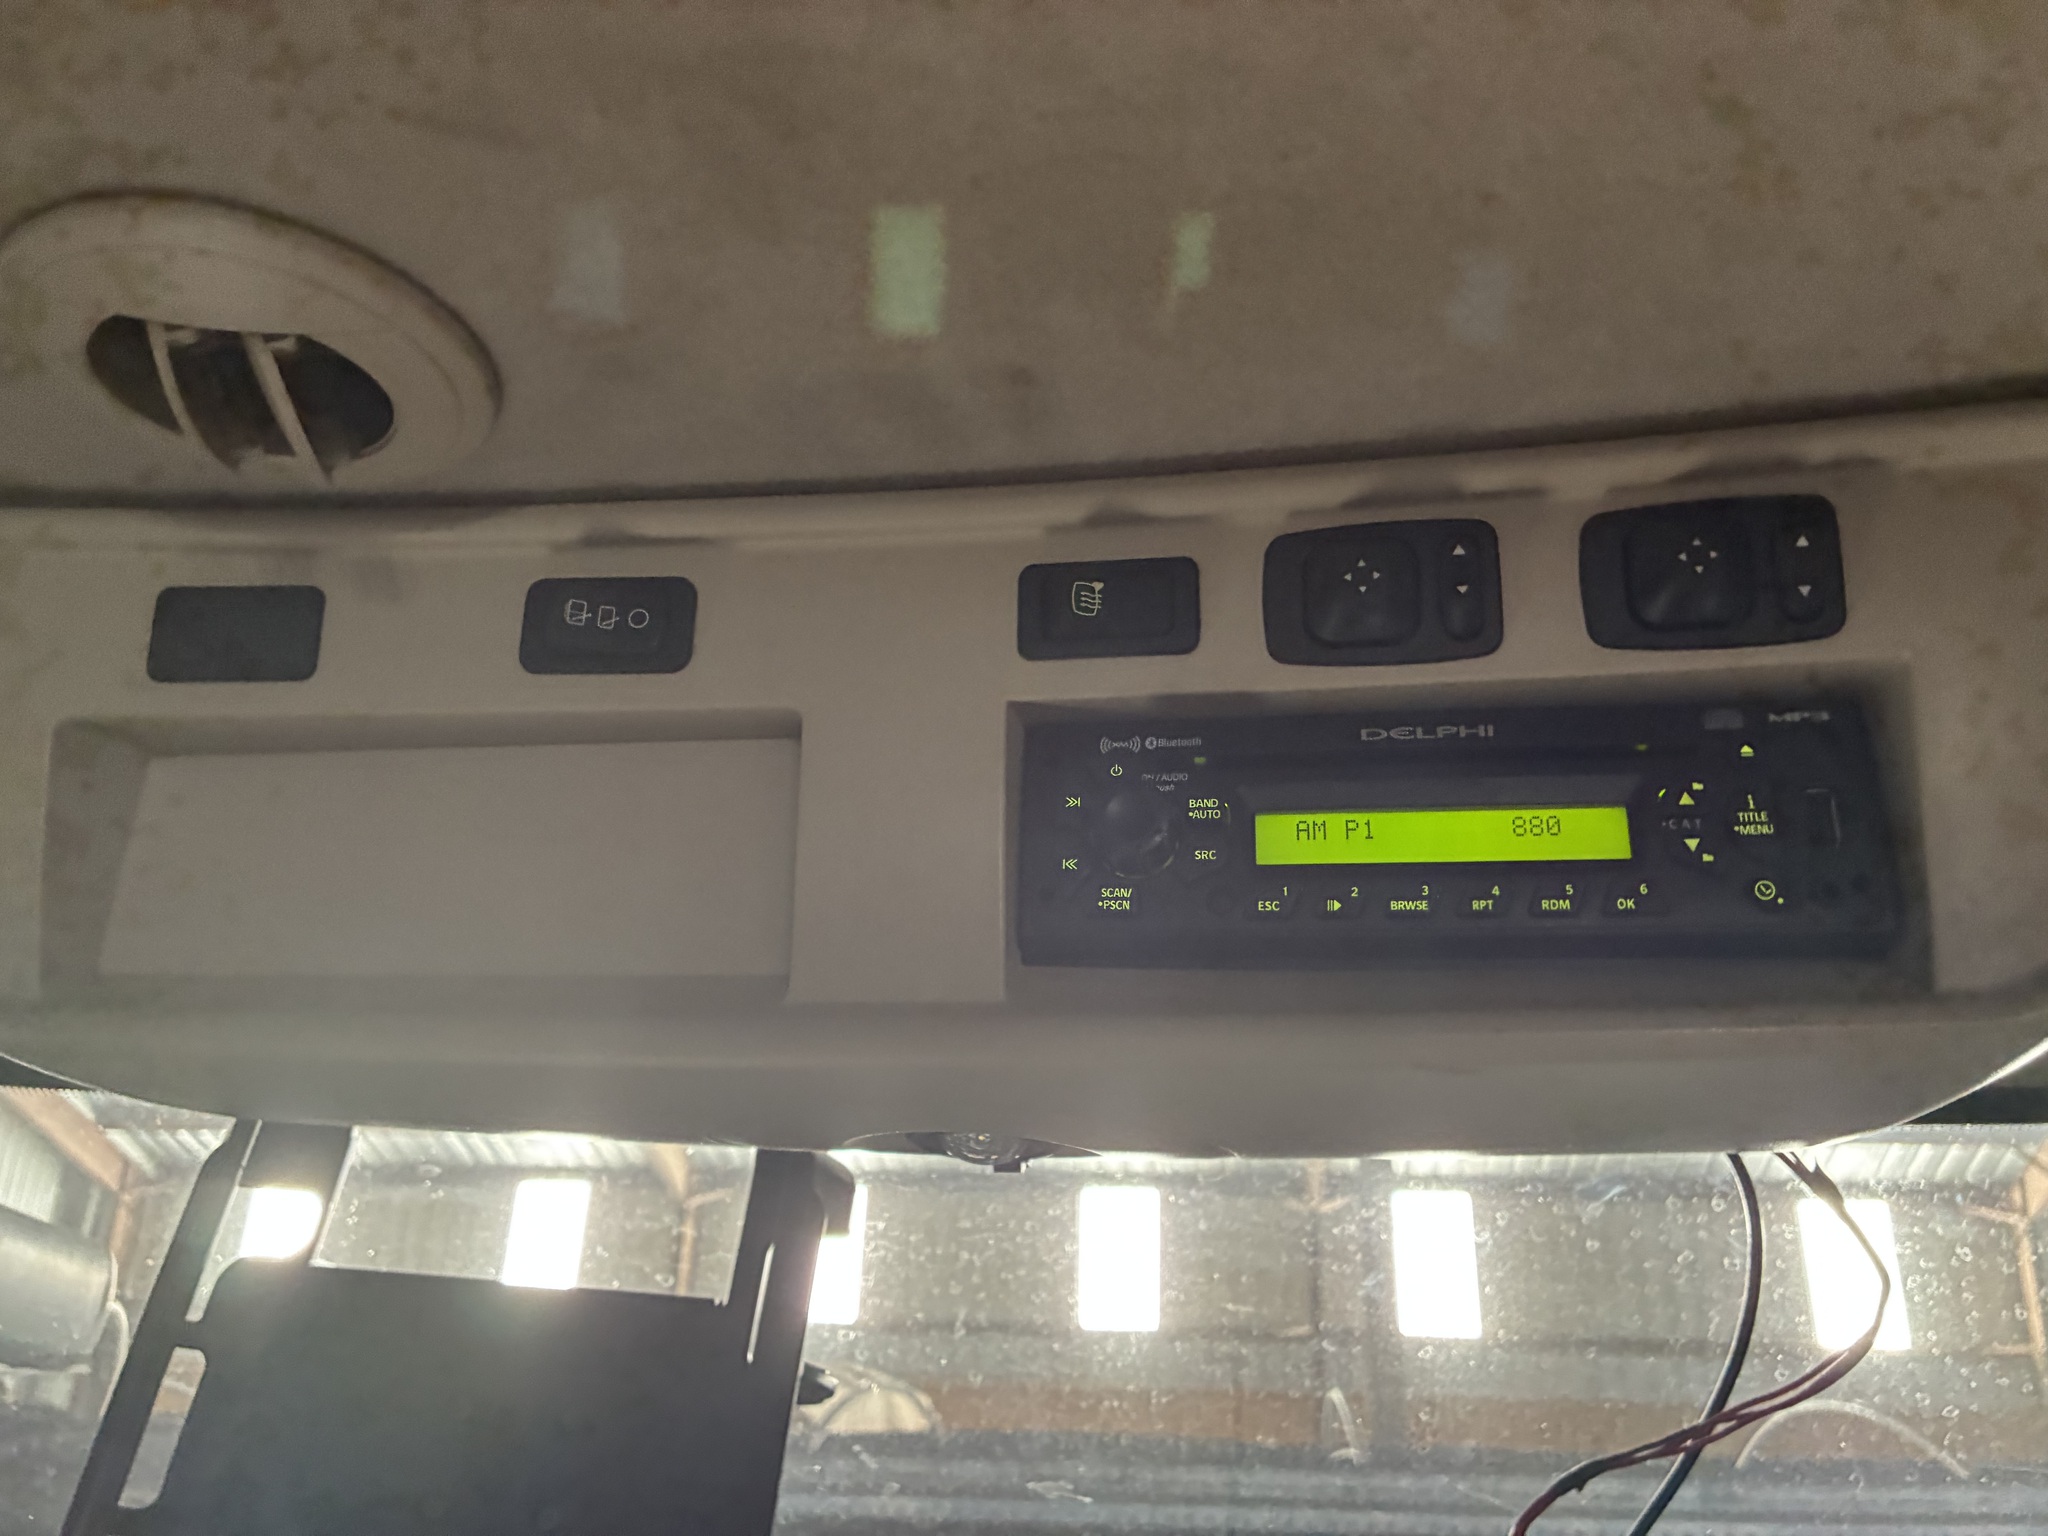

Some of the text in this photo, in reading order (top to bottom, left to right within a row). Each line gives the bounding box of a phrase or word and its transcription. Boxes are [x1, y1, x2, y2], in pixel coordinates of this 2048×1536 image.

[1360, 725, 1495, 741] DELPHI
[1158, 738, 1202, 747] Bluetooth
[1161, 773, 1188, 781] AUDIO
[1189, 798, 1219, 808] BAND
[1737, 811, 1769, 822] TITLE
[1296, 819, 1374, 841] AM P1
[1511, 815, 1562, 837] 880
[1194, 850, 1217, 860] SRC
[1101, 887, 1133, 898] SCAN/
[1283, 886, 1289, 896] 1
[1351, 887, 1359, 897] 2
[1421, 885, 1429, 896] 3
[1491, 885, 1500, 896] 4
[1565, 884, 1574, 895] 5
[1639, 883, 1648, 894] 6
[1258, 901, 1280, 911] ESC
[1390, 900, 1429, 911] BRWSE
[1472, 900, 1494, 911] RPT
[1541, 900, 1571, 910] RDM
[1616, 898, 1636, 910] OK
